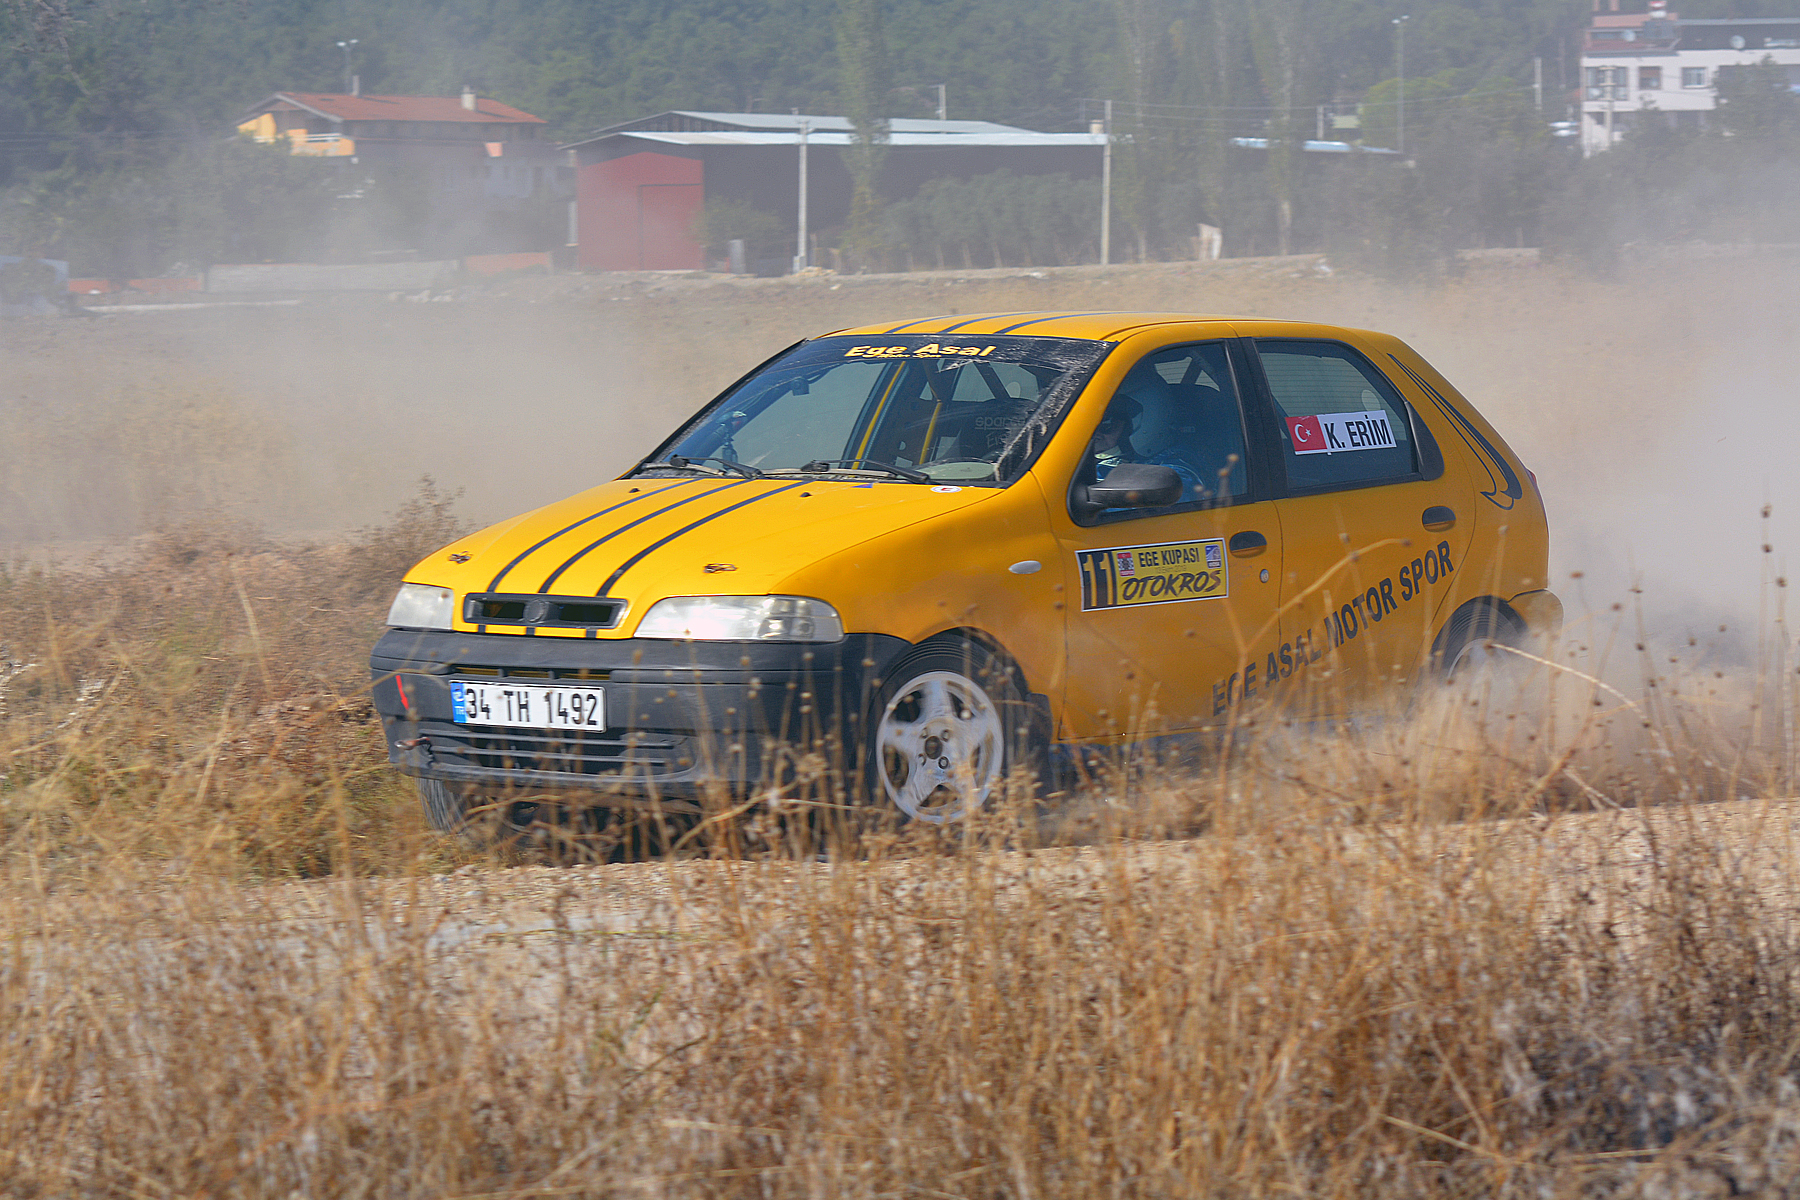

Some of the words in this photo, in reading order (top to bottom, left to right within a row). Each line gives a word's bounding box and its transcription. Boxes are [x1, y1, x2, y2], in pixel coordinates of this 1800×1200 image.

[845, 345, 908, 358] Ege
[913, 343, 997, 356] Asal
[1324, 422, 1346, 449] K.
[1345, 414, 1393, 448] ERİM
[1138, 551, 1159, 568] EGE
[1160, 547, 1200, 566] KUPASI
[1083, 552, 1114, 607] 11
[1121, 569, 1222, 600] OTOKROS
[1212, 661, 1257, 717] EGE
[1264, 628, 1322, 689] ASAL
[1324, 577, 1398, 651] MOTOR
[1399, 540, 1454, 602] SPOR
[466, 688, 490, 720] 34
[503, 690, 530, 723] TH
[543, 690, 598, 726] 1492
